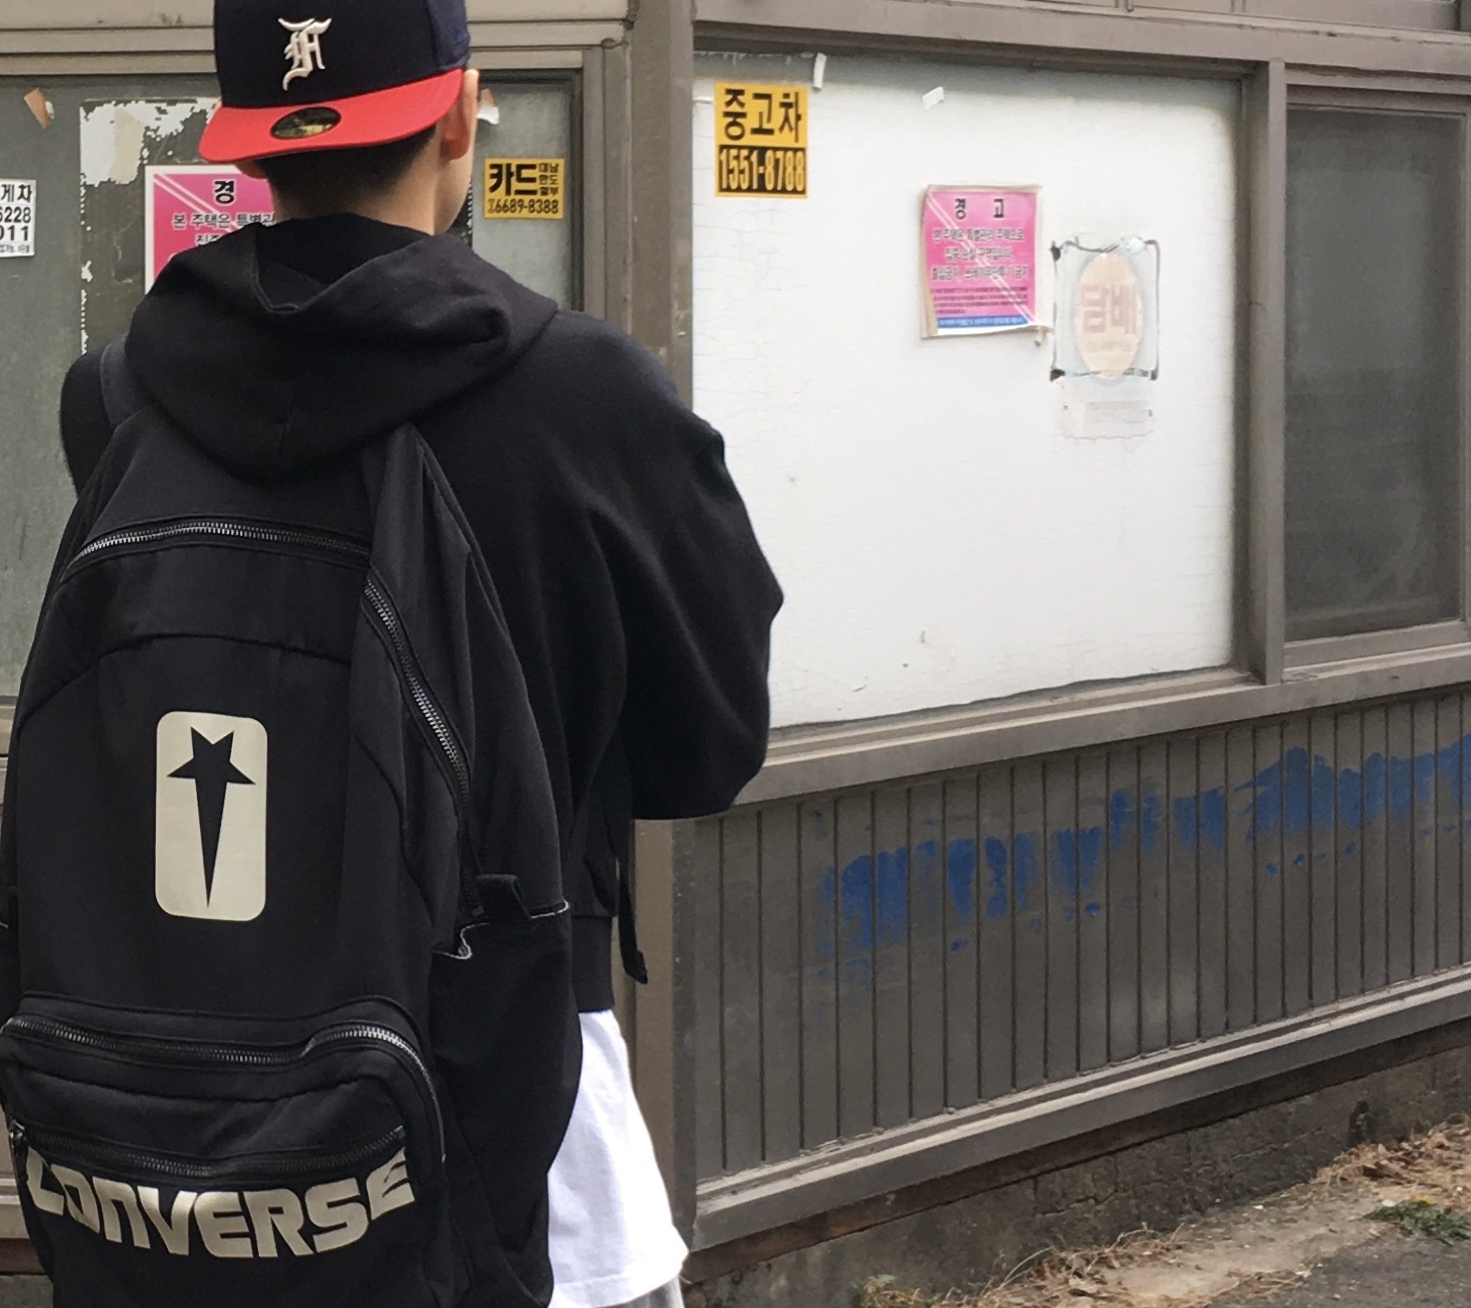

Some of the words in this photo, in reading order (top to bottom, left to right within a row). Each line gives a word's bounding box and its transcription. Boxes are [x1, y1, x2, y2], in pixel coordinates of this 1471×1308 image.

[723, 88, 802, 143] 중고차
[489, 163, 538, 196] 카드
[720, 148, 805, 192] 1551-8788
[214, 180, 235, 204] 경
[173, 214, 186, 229] 본
[192, 214, 230, 228] 주택은
[955, 198, 966, 220] 경
[993, 198, 1005, 218] 고
